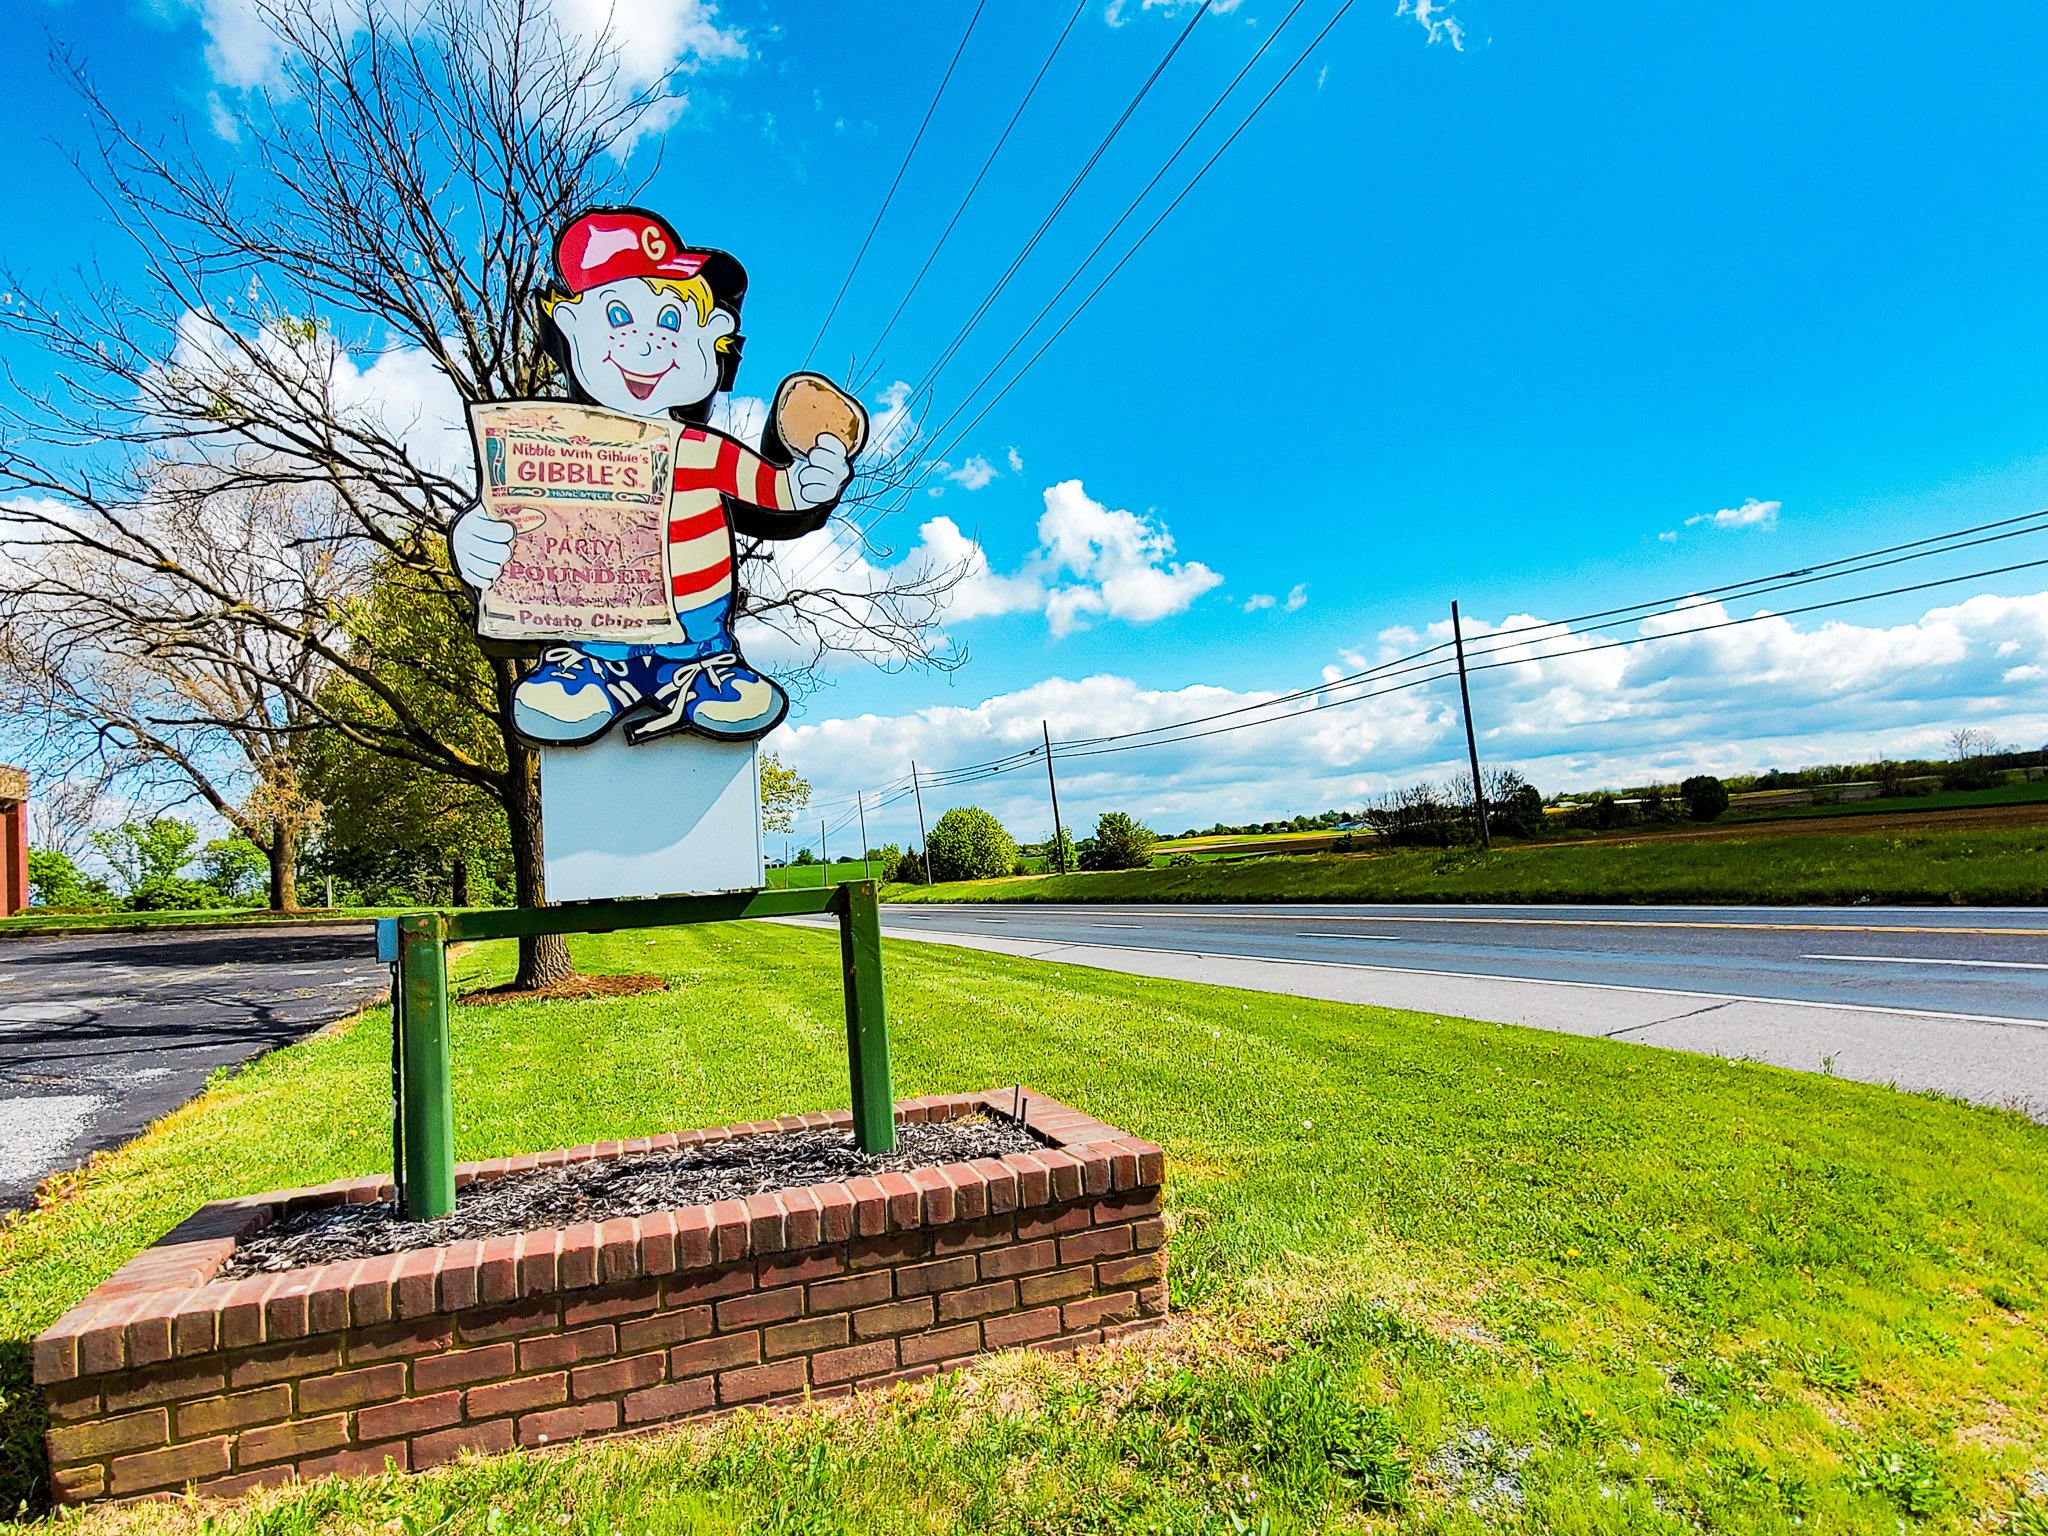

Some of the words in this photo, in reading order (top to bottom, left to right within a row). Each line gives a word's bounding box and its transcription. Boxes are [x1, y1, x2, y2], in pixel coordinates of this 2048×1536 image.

[641, 226, 667, 261] G
[512, 442, 556, 457] Nibble
[560, 448, 593, 460] With
[517, 460, 639, 488] GIBBLE'S
[546, 537, 614, 556] PARTY
[508, 563, 651, 585] POUNDER
[519, 610, 583, 628] Potato
[591, 613, 644, 629] Chips
